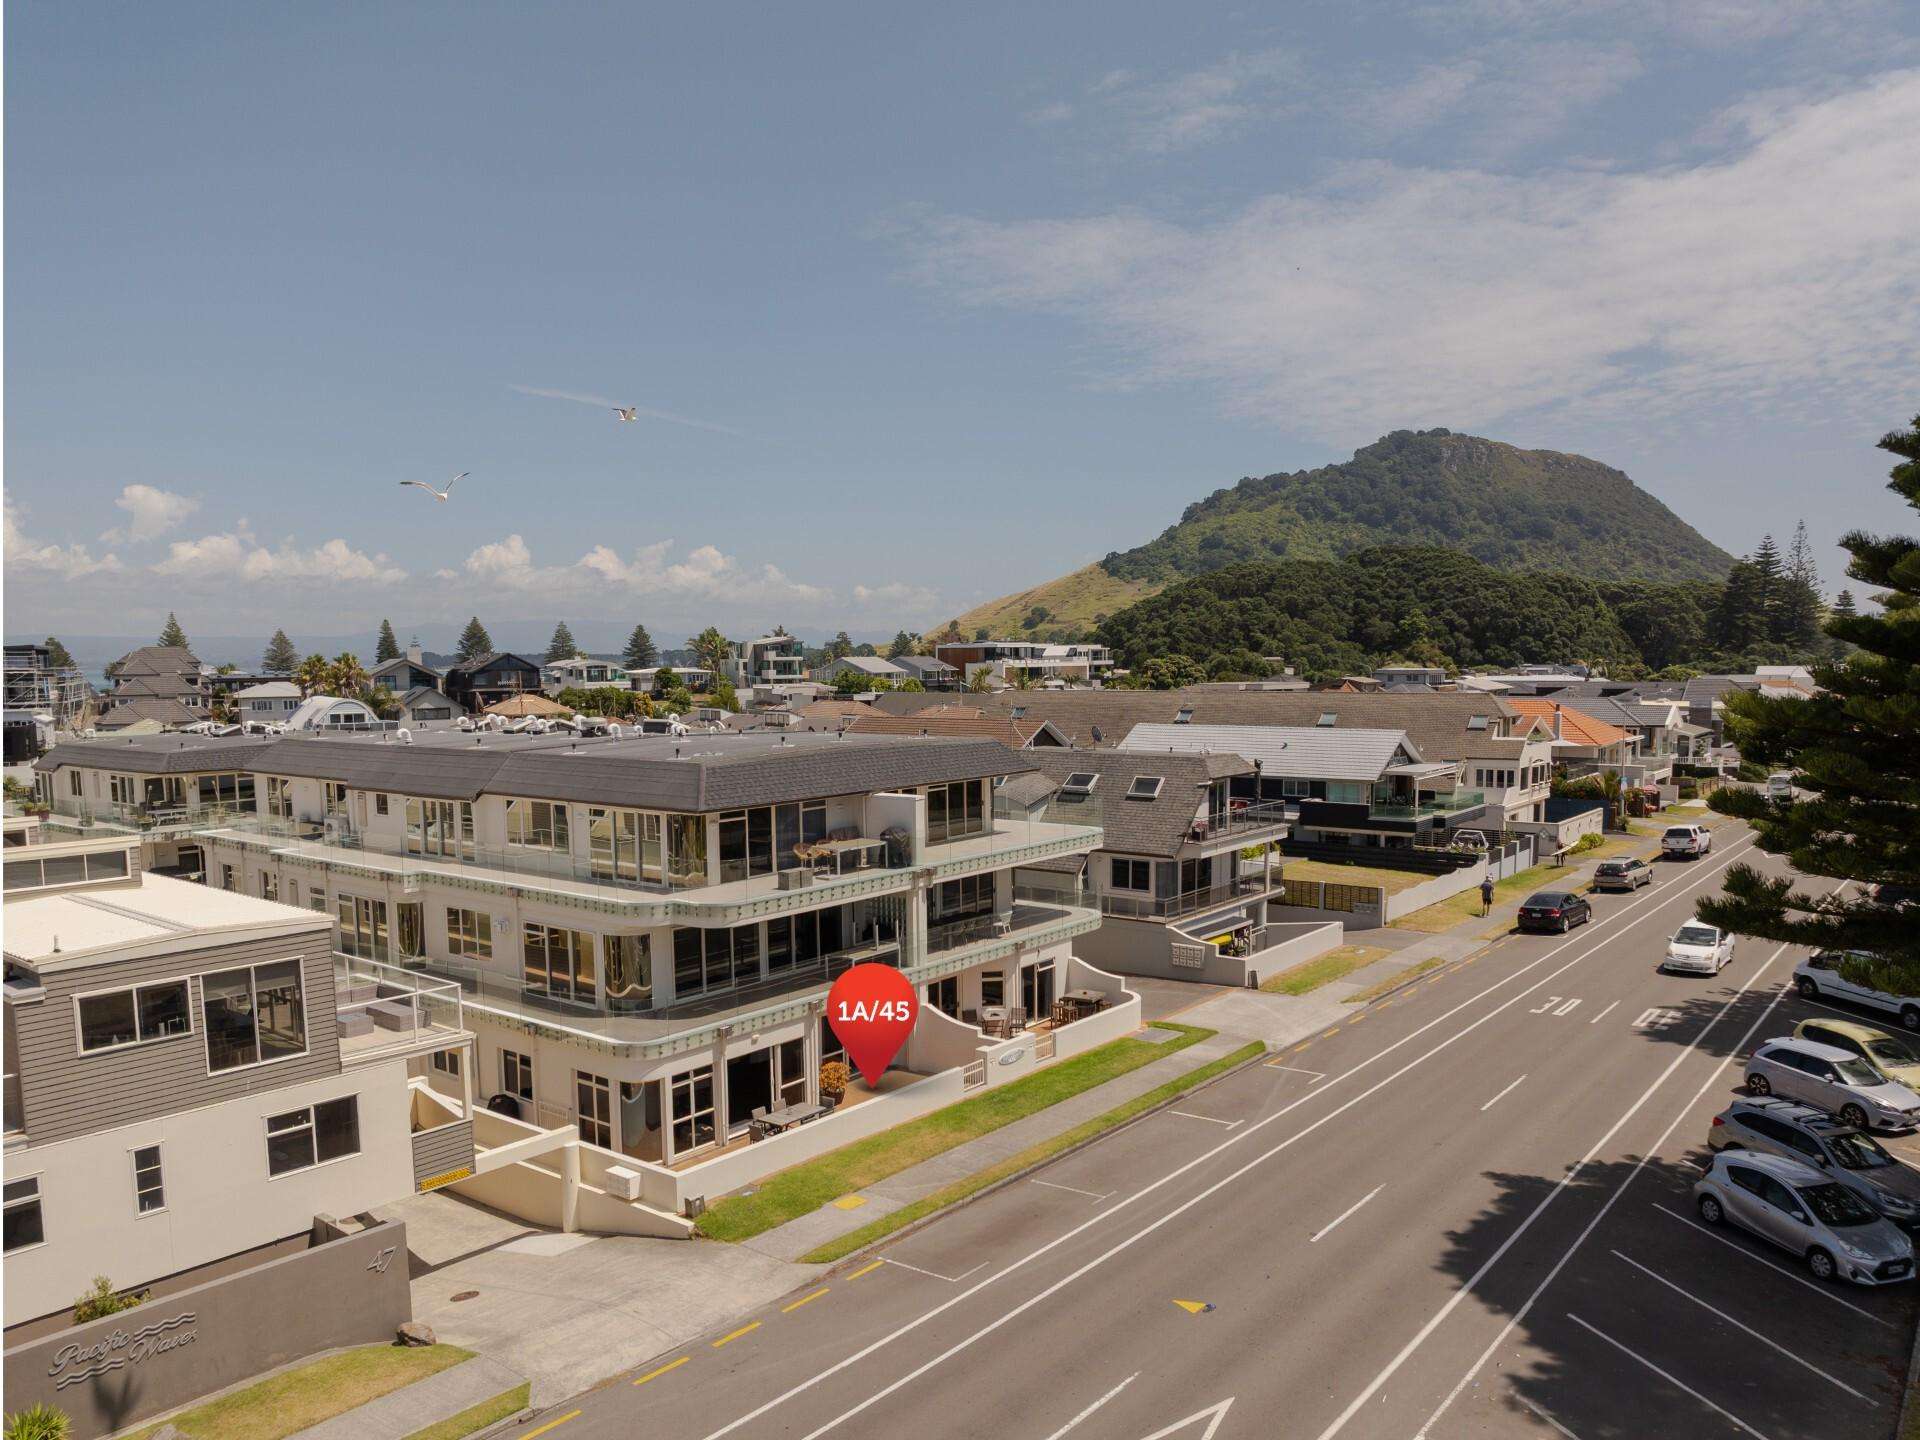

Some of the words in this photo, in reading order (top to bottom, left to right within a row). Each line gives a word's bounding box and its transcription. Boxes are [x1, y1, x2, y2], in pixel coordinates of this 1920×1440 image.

[1529, 996, 1583, 1016] 30
[366, 1246, 397, 1273] 47
[49, 1329, 130, 1376] Pacific
[129, 1330, 198, 1364] Waves
